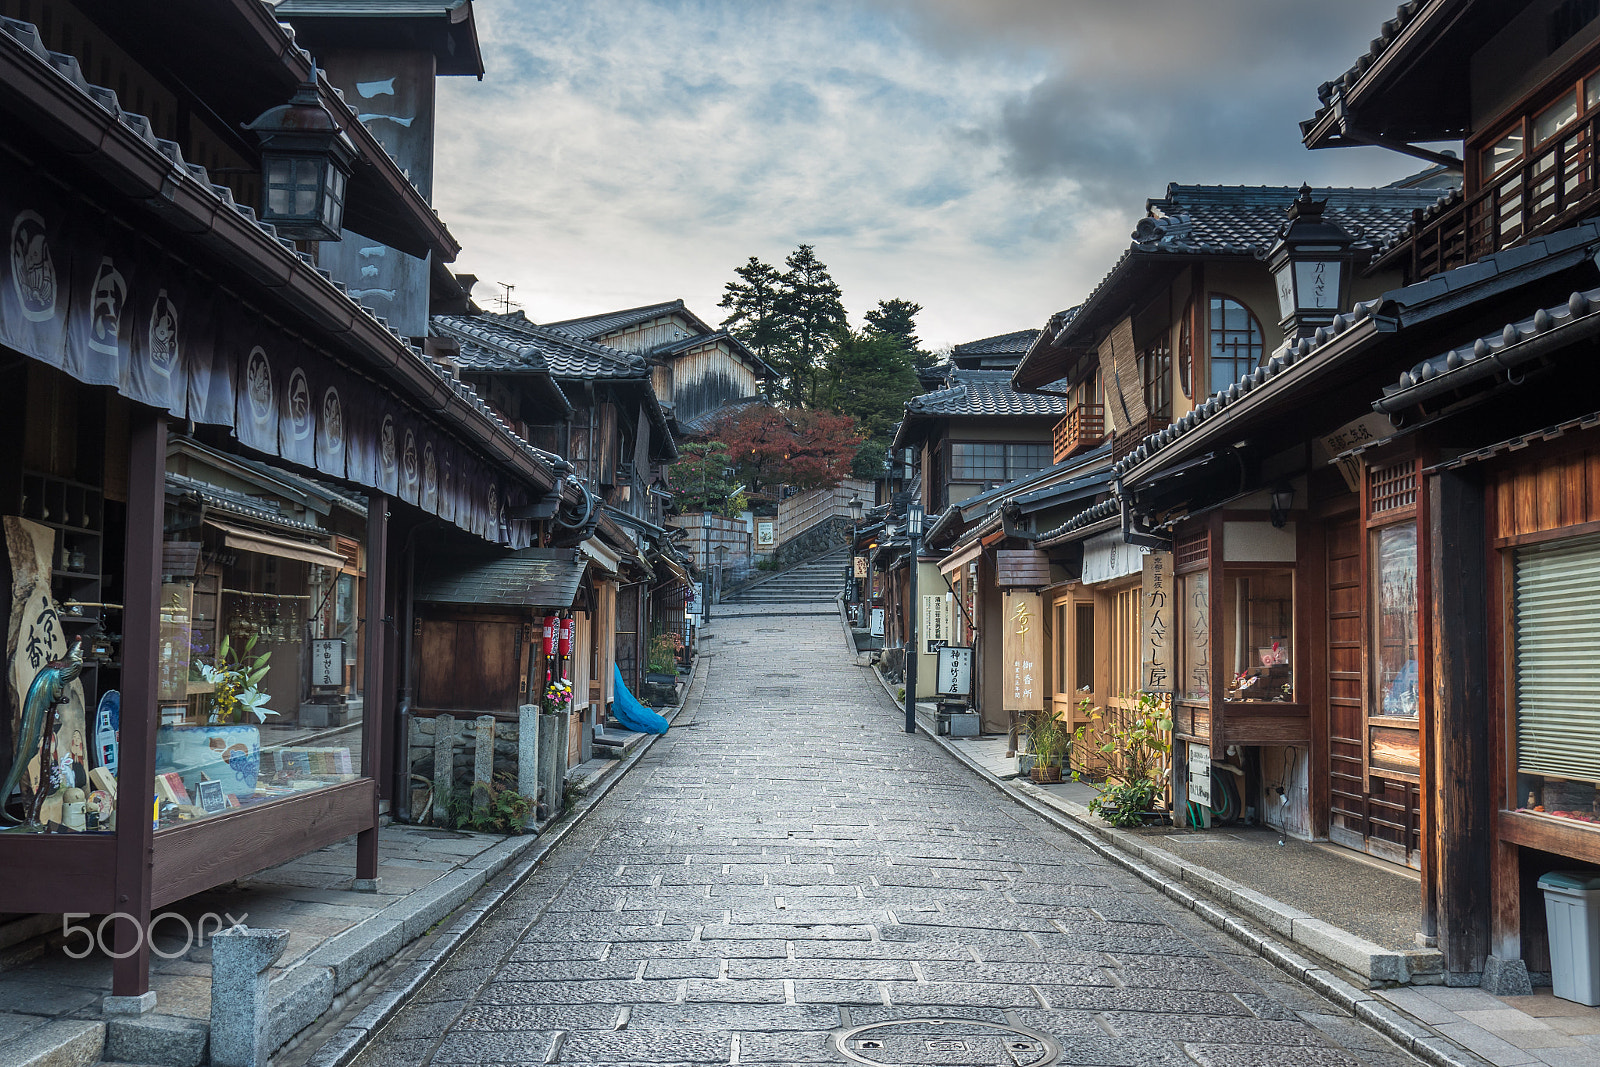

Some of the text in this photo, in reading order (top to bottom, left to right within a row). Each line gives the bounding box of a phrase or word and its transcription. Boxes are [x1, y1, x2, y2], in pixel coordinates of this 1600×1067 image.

[1148, 590, 1167, 687] かんざし屋
[948, 649, 961, 693] 神田竹の店
[1022, 660, 1033, 700] 御香所
